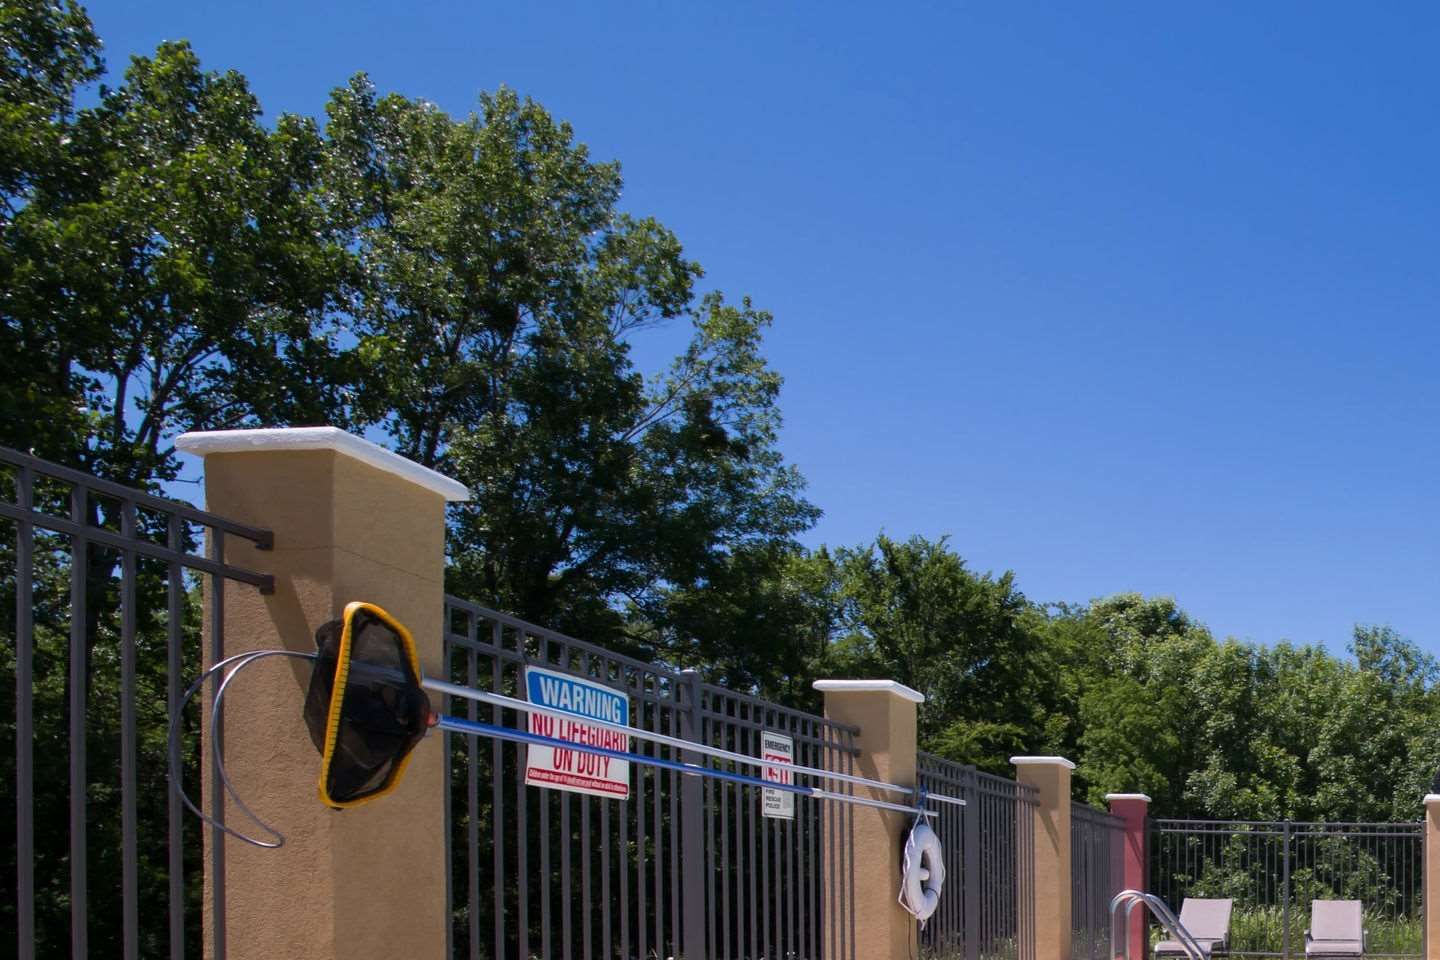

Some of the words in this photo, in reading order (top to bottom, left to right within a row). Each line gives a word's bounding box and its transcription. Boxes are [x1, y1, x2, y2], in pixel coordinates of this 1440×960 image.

[539, 677, 621, 722] WARNING
[533, 713, 553, 737] NO
[765, 739, 790, 753] EMERGENCY
[553, 746, 572, 771] ON
[578, 752, 611, 778] DUTY
